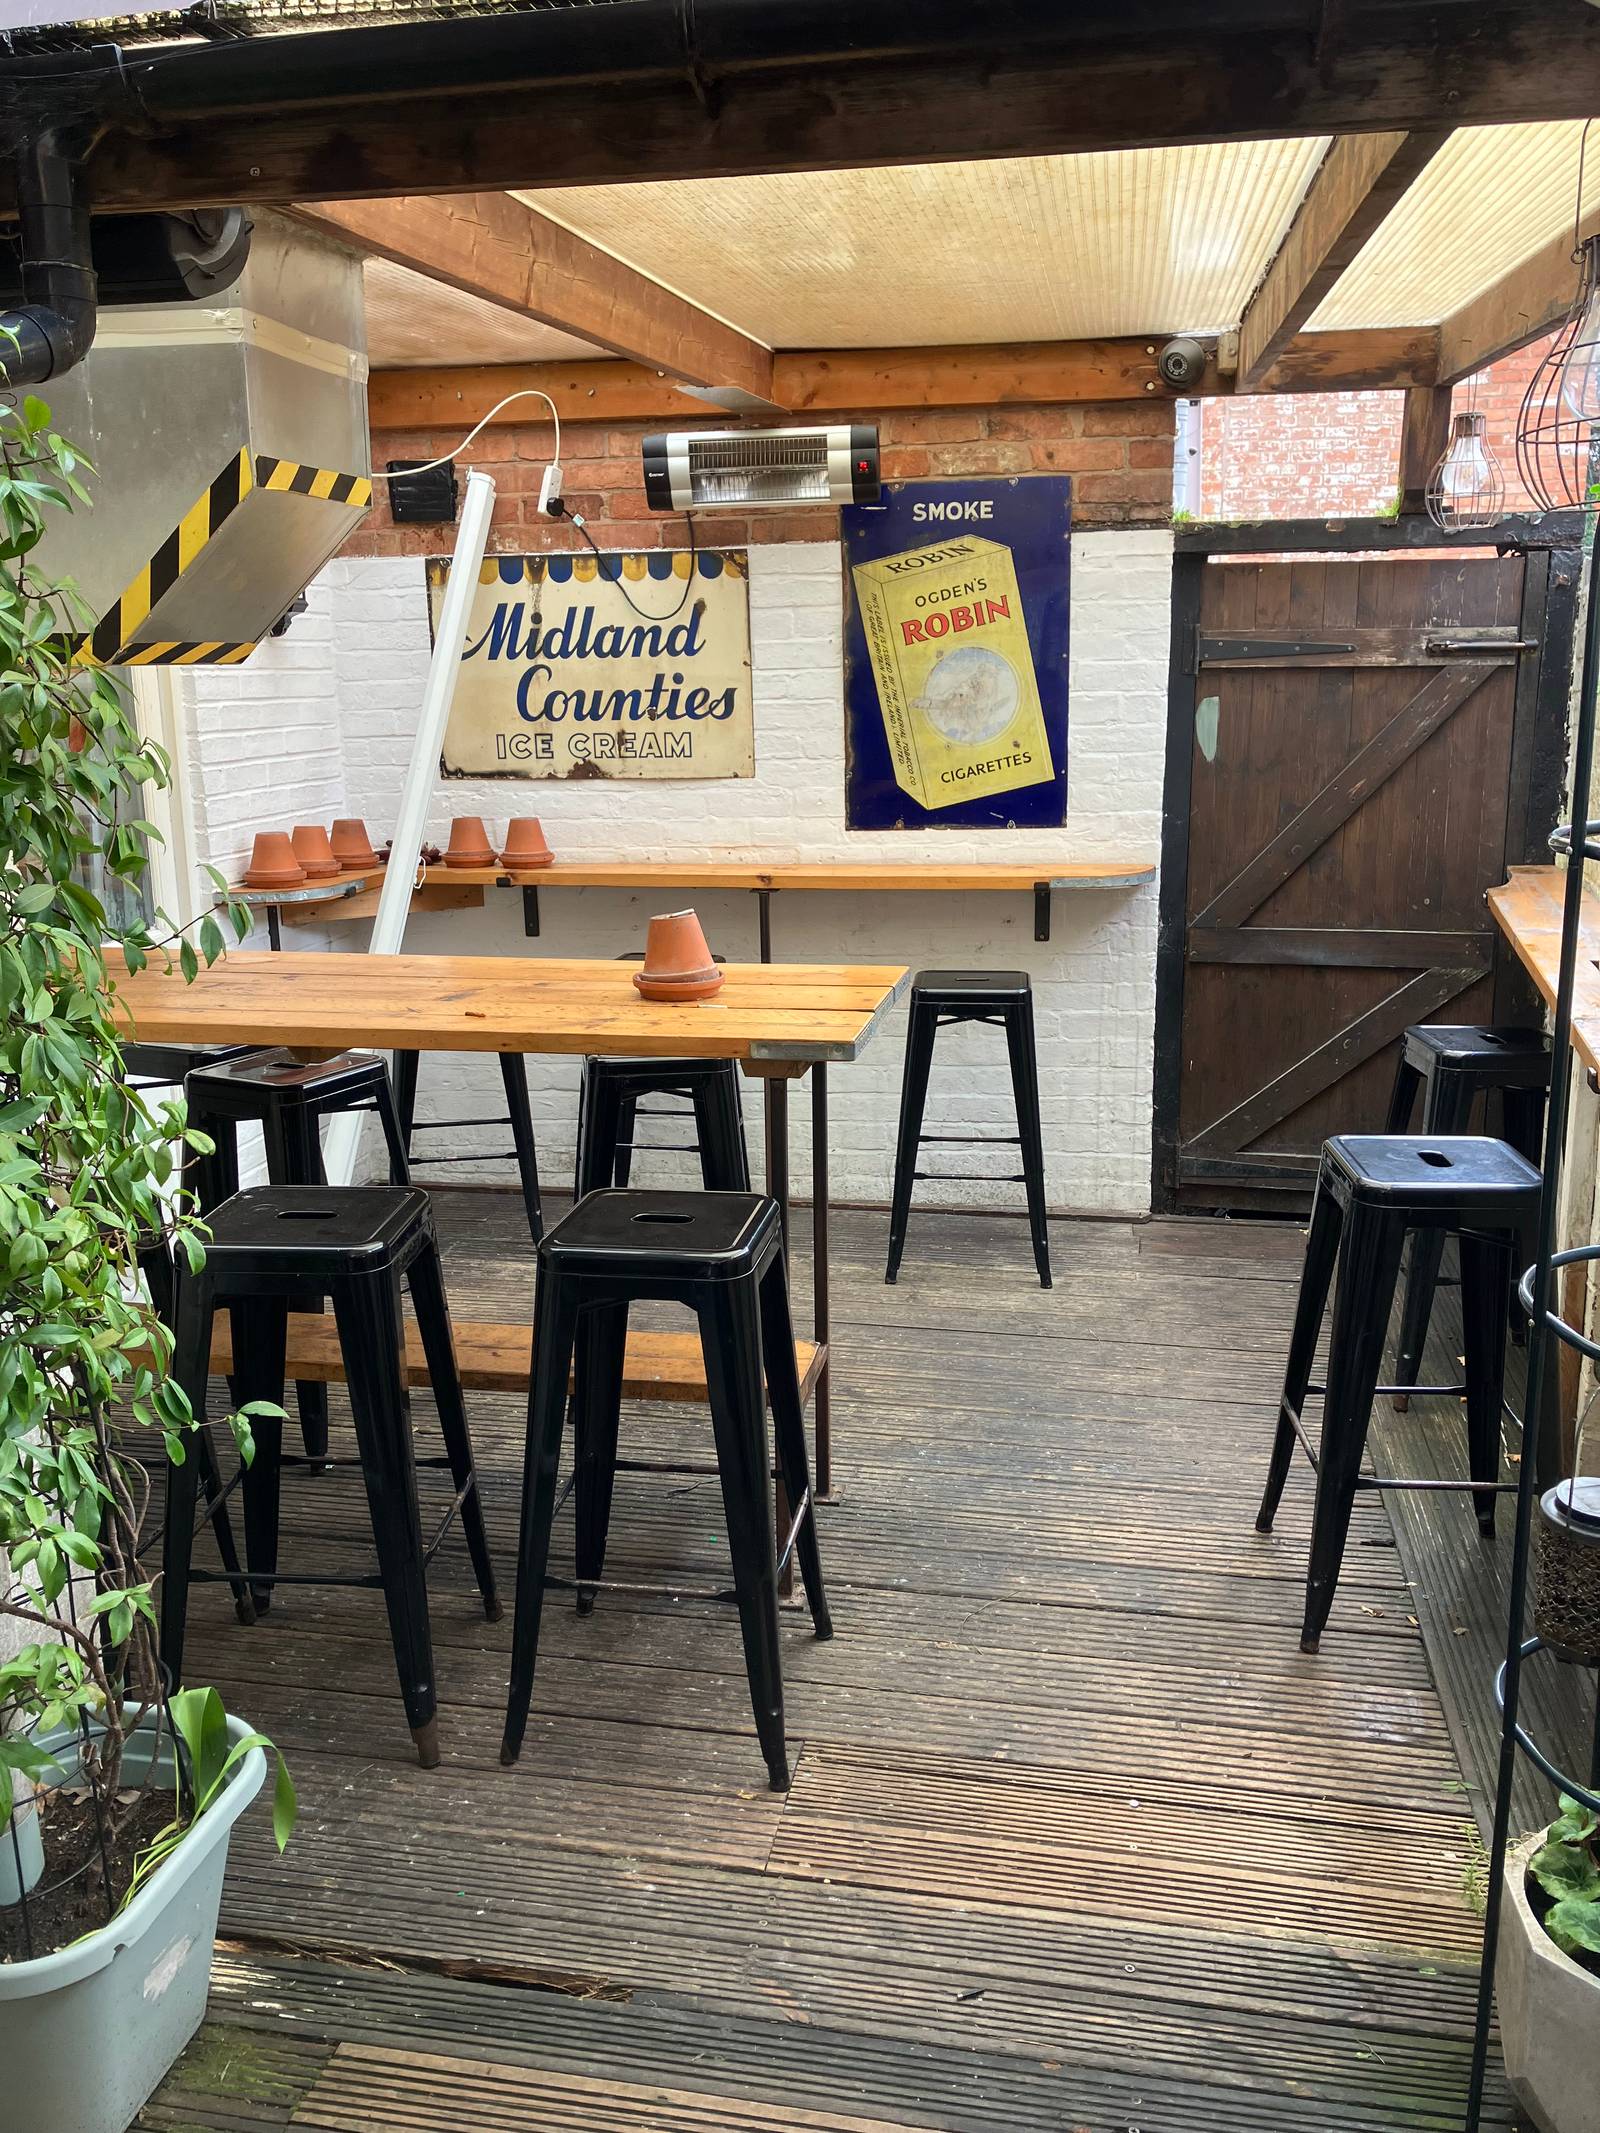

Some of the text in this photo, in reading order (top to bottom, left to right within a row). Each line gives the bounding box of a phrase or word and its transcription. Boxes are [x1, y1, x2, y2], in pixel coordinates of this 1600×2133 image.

[912, 500, 994, 522] SMOKE
[883, 544, 975, 574] ROBIN
[914, 577, 988, 608] OGDEN'S
[461, 600, 706, 661] Midland
[900, 594, 1011, 646] ROBIN
[516, 664, 739, 722] Counties
[496, 732, 693, 760] ICE CREAM
[940, 752, 1033, 784] CIGARETTES
